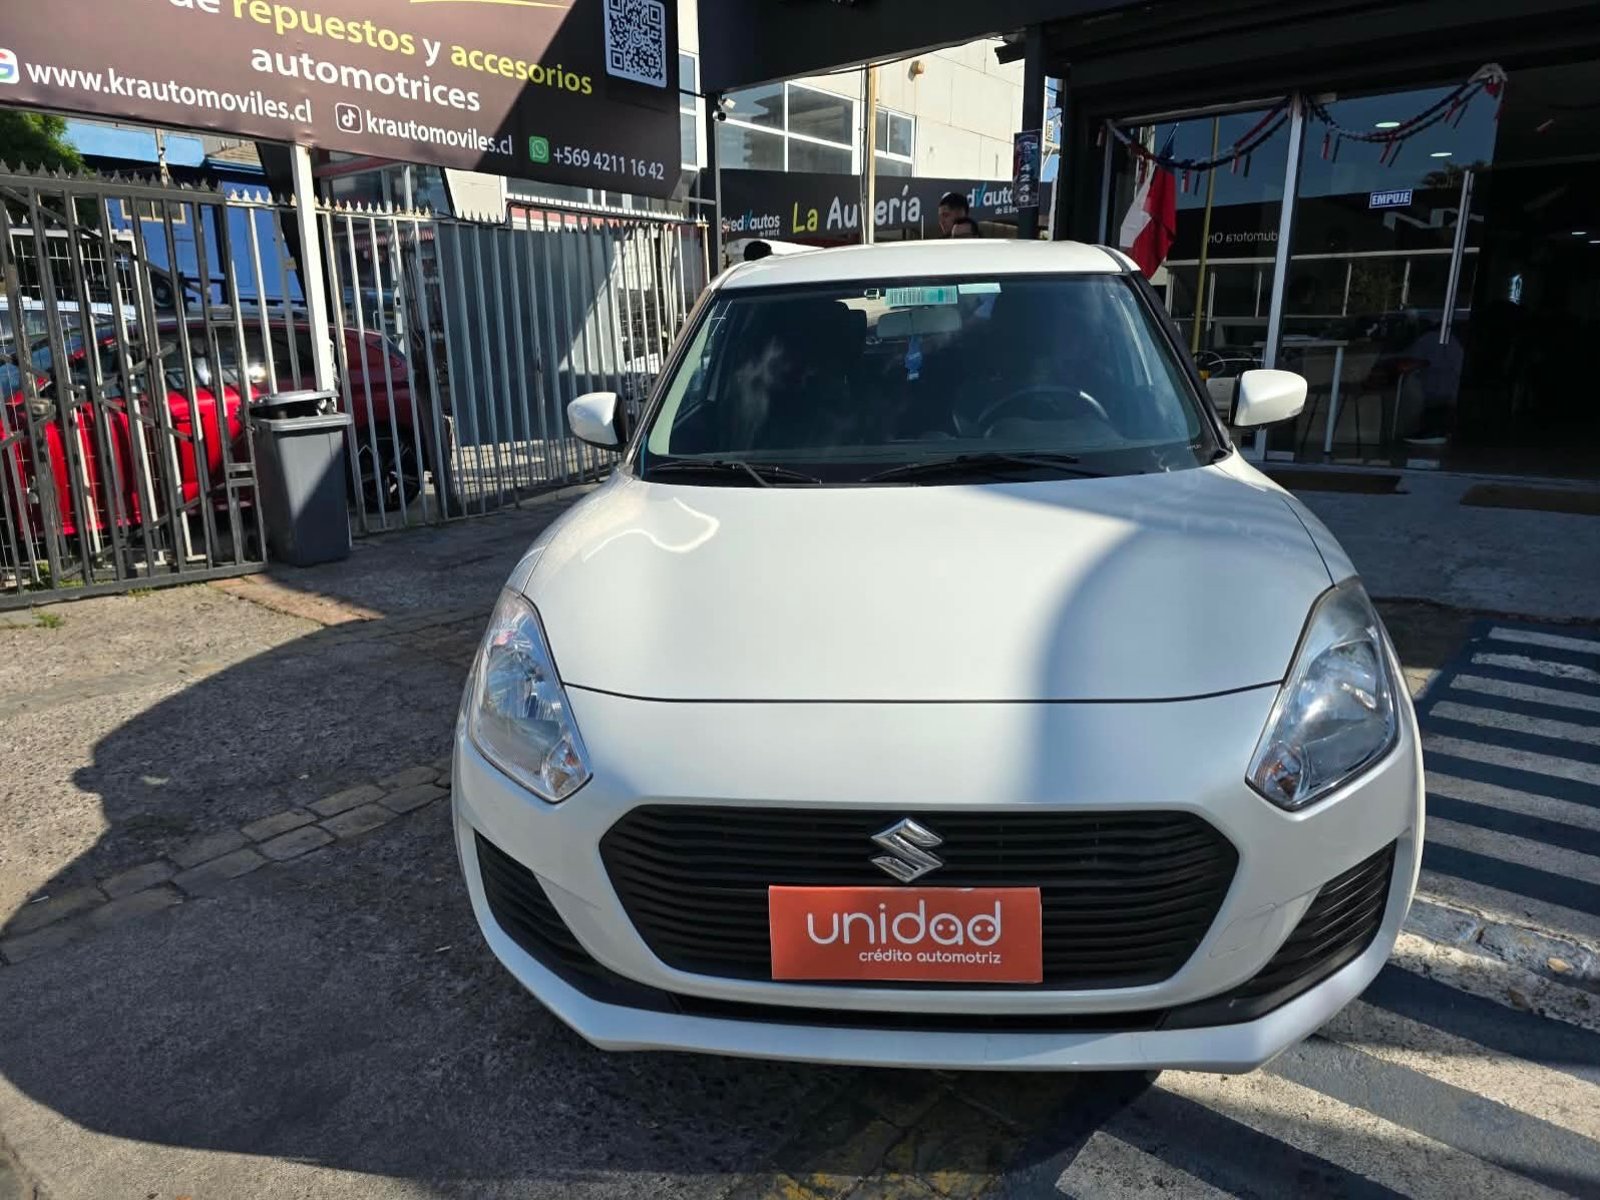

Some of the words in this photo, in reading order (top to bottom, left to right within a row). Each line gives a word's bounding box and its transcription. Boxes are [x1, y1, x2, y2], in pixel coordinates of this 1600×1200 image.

[232, 0, 416, 56] repuestos
[422, 38, 441, 67] y
[451, 45, 593, 94] accesorios
[25, 62, 313, 123] www.krautomoviles.cl
[250, 48, 481, 112] automotrices
[365, 109, 513, 156] krautomoviles.cl
[553, 147, 590, 167] +569
[592, 157, 626, 174] 4211
[792, 201, 819, 234] La
[826, 184, 921, 231] Auería
[1371, 190, 1410, 205] EMPUJE
[807, 899, 1001, 946] unidad
[858, 948, 912, 962] crédito
[916, 950, 1001, 964] automotriz
